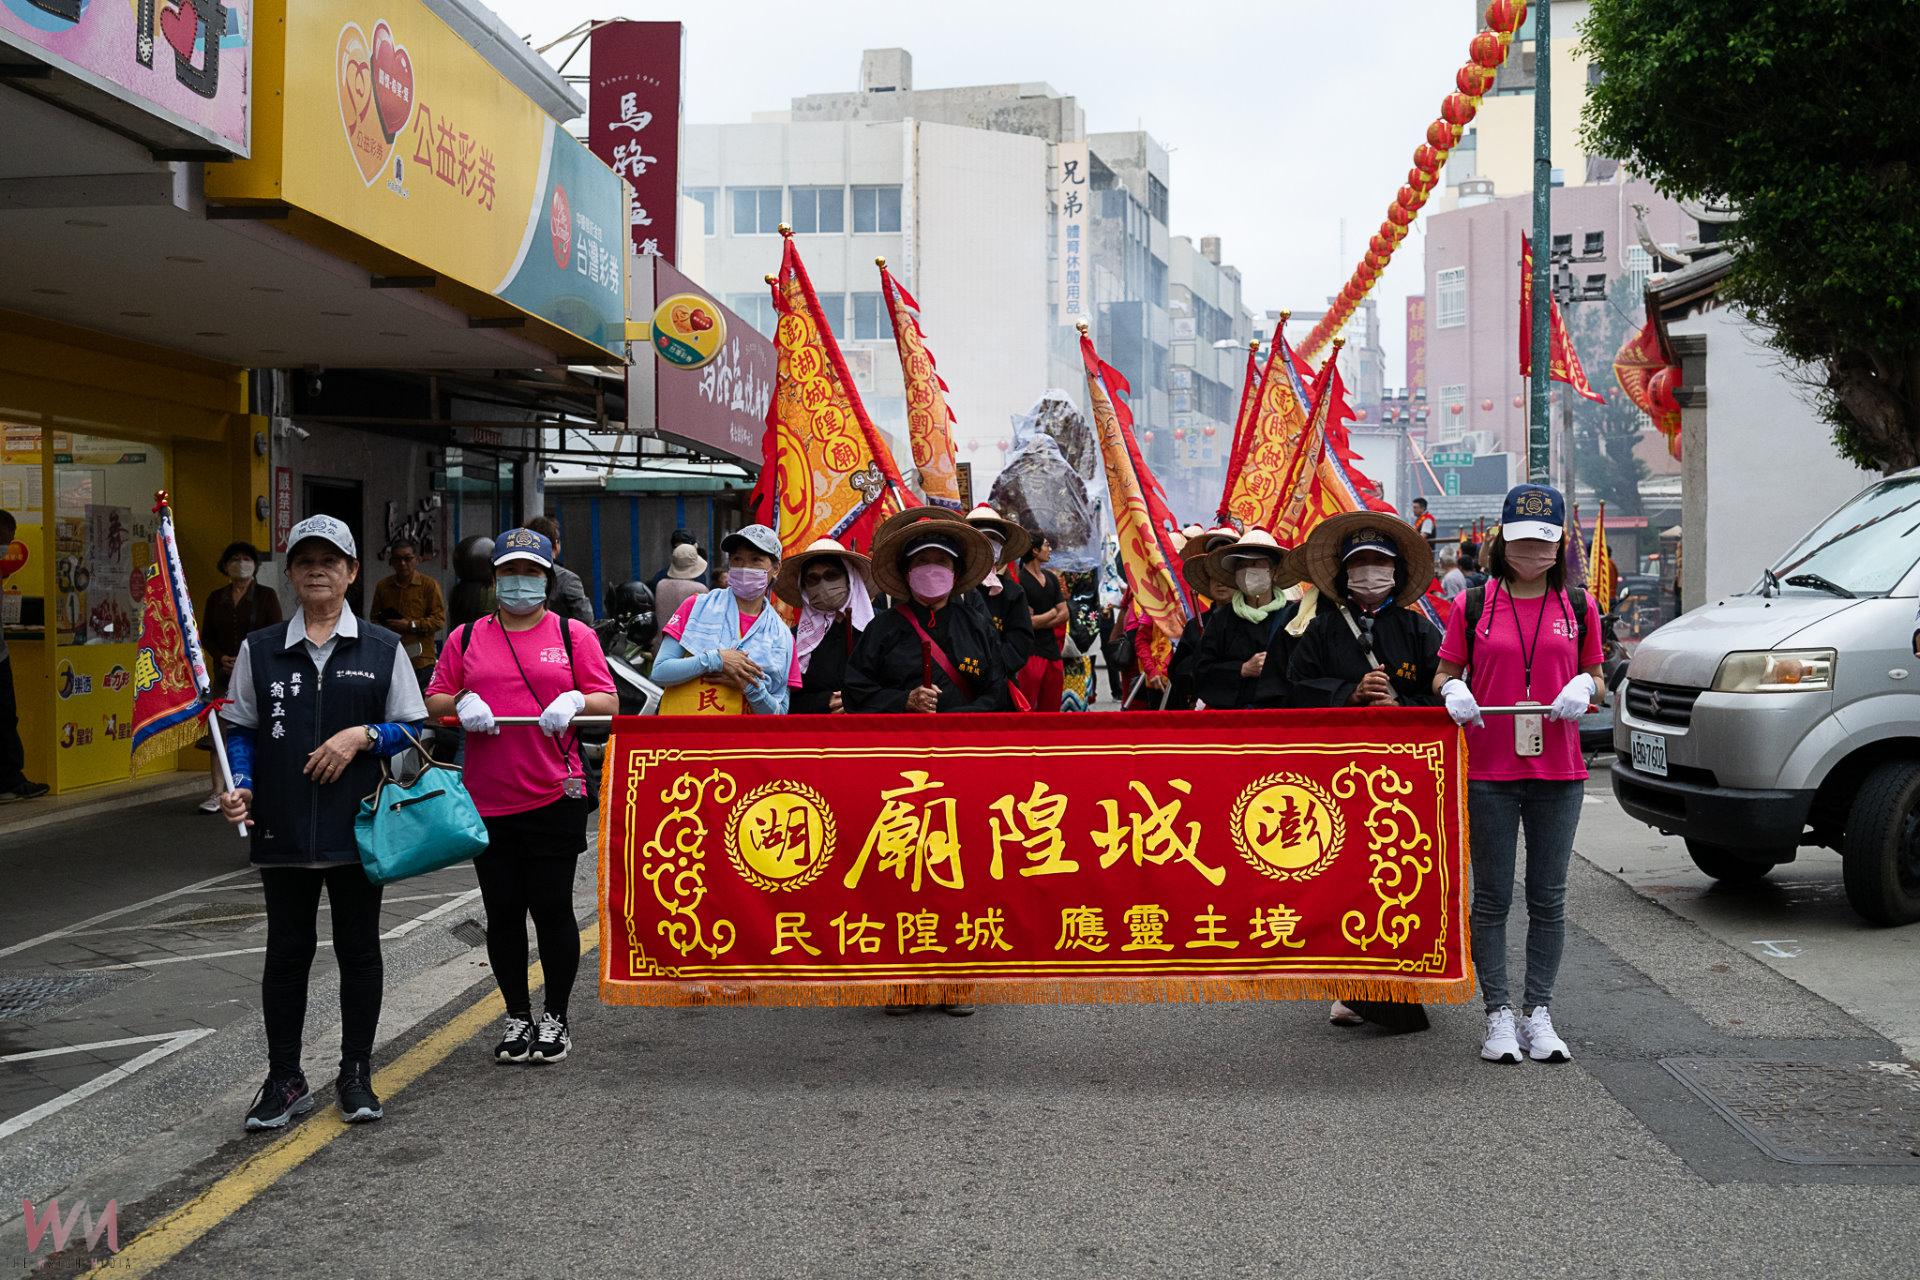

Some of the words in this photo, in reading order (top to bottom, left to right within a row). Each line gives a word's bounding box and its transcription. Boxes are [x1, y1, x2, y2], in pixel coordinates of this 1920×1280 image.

[600, 74, 629, 87] Since
[413, 102, 496, 211] 公益彩券
[1062, 160, 1085, 219] 兄弟
[577, 233, 619, 295] 台灣彩券
[781, 317, 858, 467] 澎湖城隍廟
[60, 665, 92, 699] 大樂透
[103, 671, 130, 691] 威力彩
[290, 671, 302, 696] 監事
[61, 722, 93, 749] 3星彩
[751, 805, 822, 869] 湖
